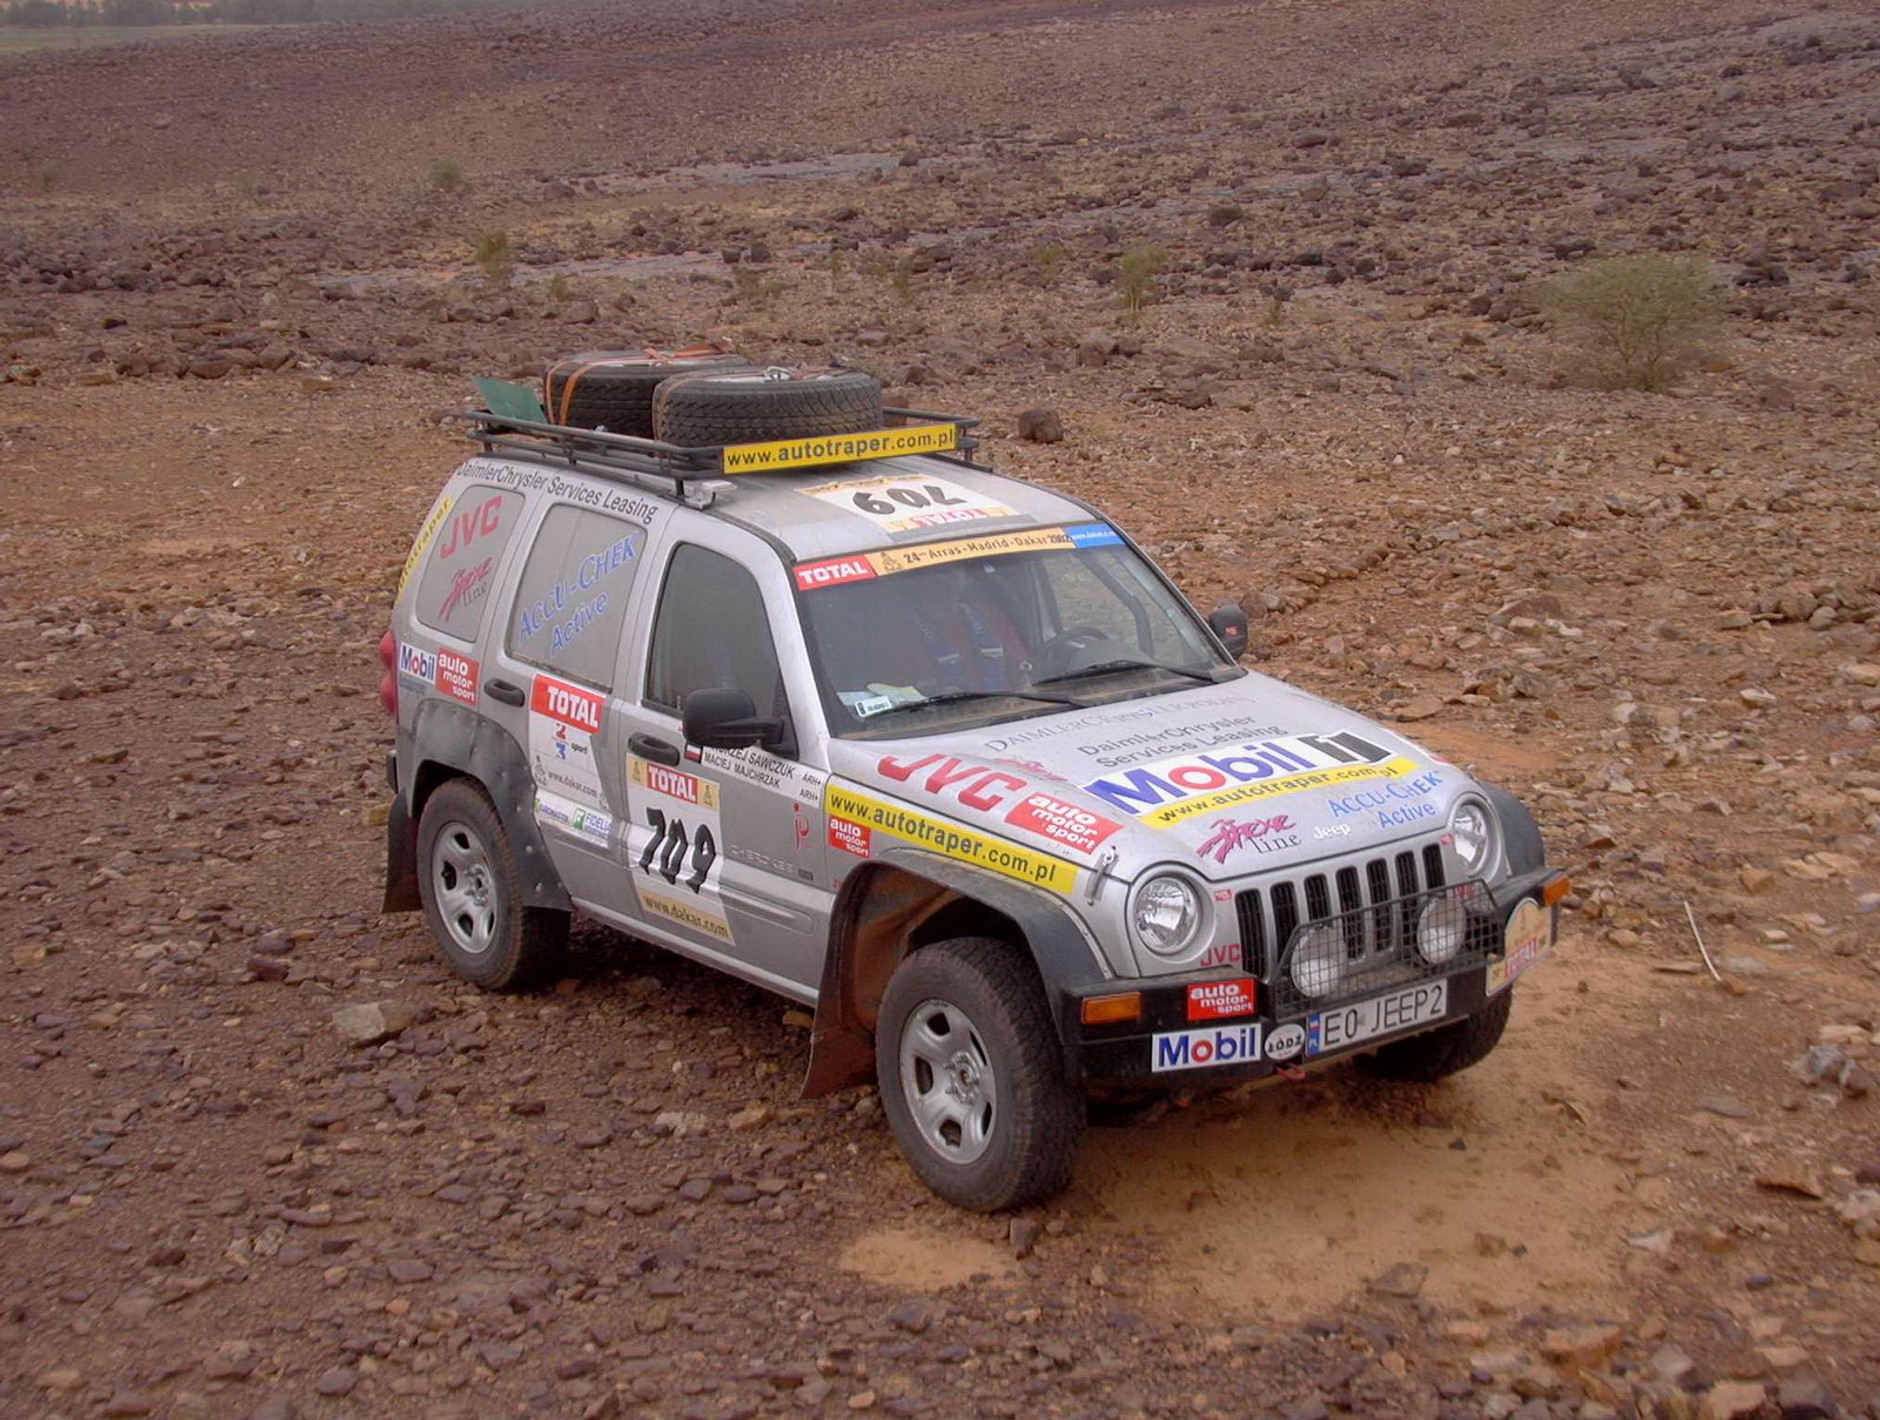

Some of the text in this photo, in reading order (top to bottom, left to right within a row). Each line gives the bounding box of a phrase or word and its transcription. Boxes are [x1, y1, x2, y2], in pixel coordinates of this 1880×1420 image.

[727, 428, 954, 467] www.autotraper.com.pl
[457, 462, 659, 525] DaimlerChrysler Services Leasing
[852, 484, 968, 516] 709
[440, 495, 503, 560] JVC
[520, 531, 641, 643] ACCU-CHEK
[798, 562, 870, 584] TOTAL
[550, 592, 608, 655] Active
[400, 644, 435, 681] Mobil
[438, 653, 468, 676] auto
[442, 670, 474, 689] motor
[452, 685, 475, 702] sport
[546, 685, 599, 729] TOTAL
[570, 742, 588, 755] sport
[1077, 714, 1257, 756] DaimlerChrysler
[1096, 723, 1290, 768] Services Leasing
[704, 750, 732, 770] MACIEJ
[733, 763, 781, 789] MAJCHRZAK
[748, 753, 797, 780] SAWCZUK
[1084, 741, 1318, 815] Mobil
[648, 764, 696, 802] TOTAL
[876, 754, 1028, 813] JVC
[1327, 771, 1443, 818] ACCU-CHEK
[1028, 795, 1097, 826] auto
[1031, 809, 1101, 837] motor
[1378, 803, 1436, 829] Active
[829, 817, 862, 837] auto
[830, 794, 1057, 882] www.autotraper.com.pl
[835, 831, 866, 848] motor
[1044, 824, 1097, 851] sport
[1313, 823, 1351, 840] Jeep
[638, 806, 717, 894] 709
[845, 842, 870, 858] sport
[1248, 834, 1303, 854] line
[1200, 943, 1242, 967] JVC
[1190, 983, 1240, 1001] auto
[1200, 994, 1250, 1008] motor
[1217, 1002, 1254, 1014] sport
[1370, 984, 1444, 1033] JEEP2
[1158, 1026, 1257, 1068] Mobil
